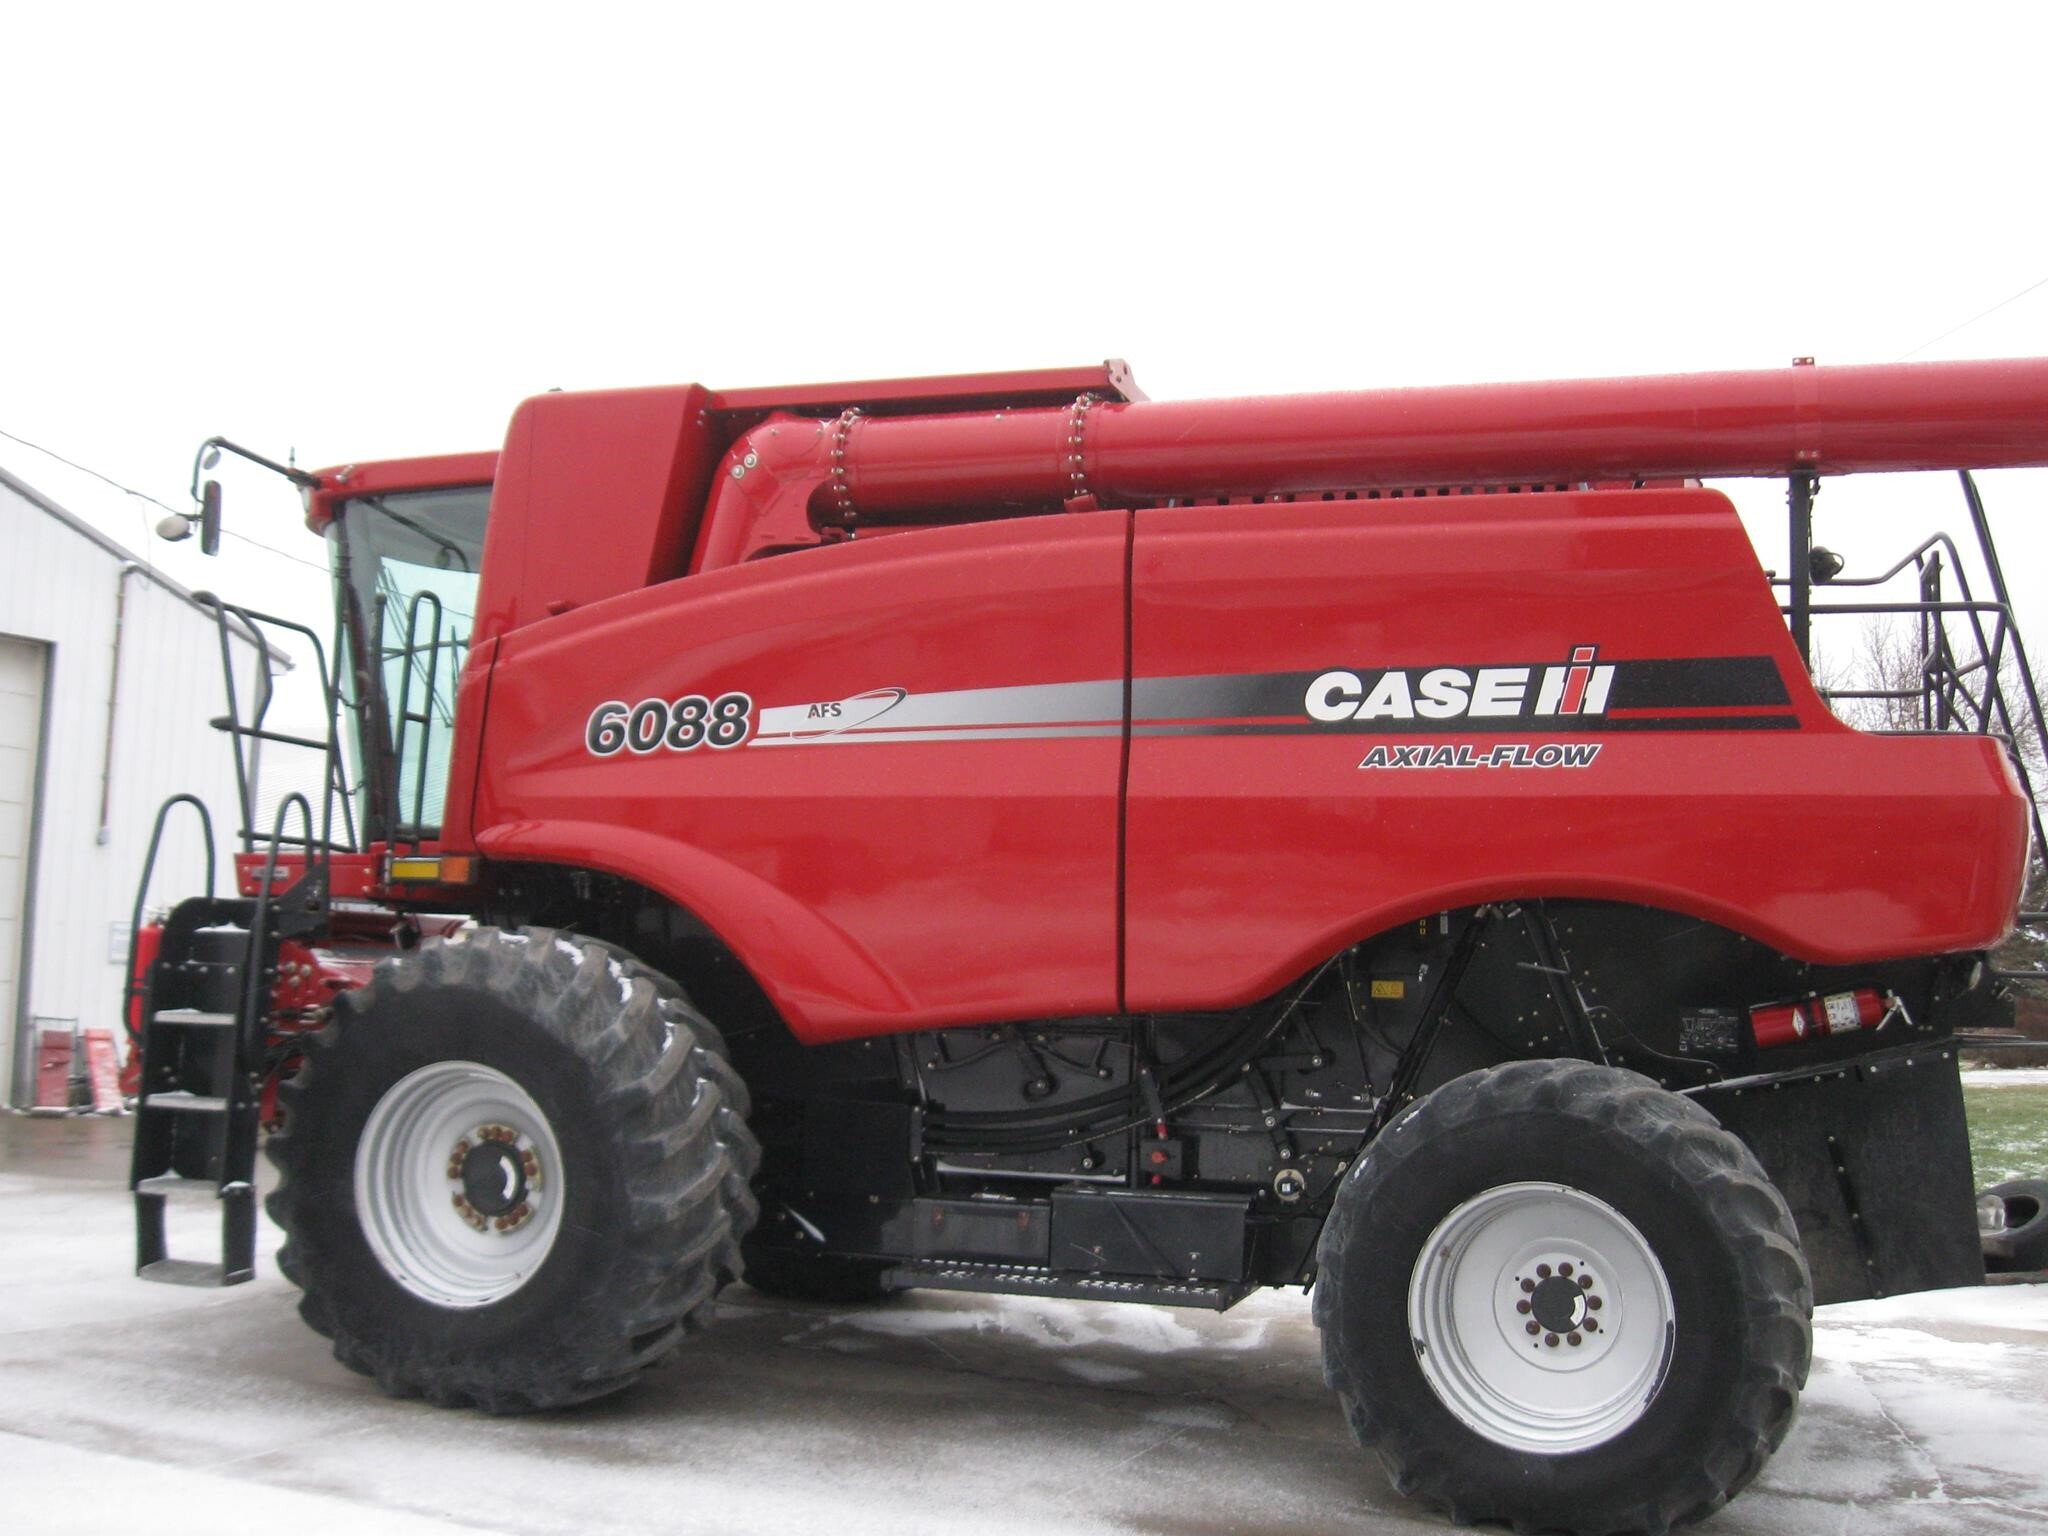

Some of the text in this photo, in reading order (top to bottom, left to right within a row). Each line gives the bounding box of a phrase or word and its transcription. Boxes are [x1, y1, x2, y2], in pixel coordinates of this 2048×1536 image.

[807, 702, 842, 719] AFS
[1304, 668, 1531, 722] CASE
[585, 691, 753, 757] 6088
[1359, 743, 1602, 769] AXIAL-FLOW
